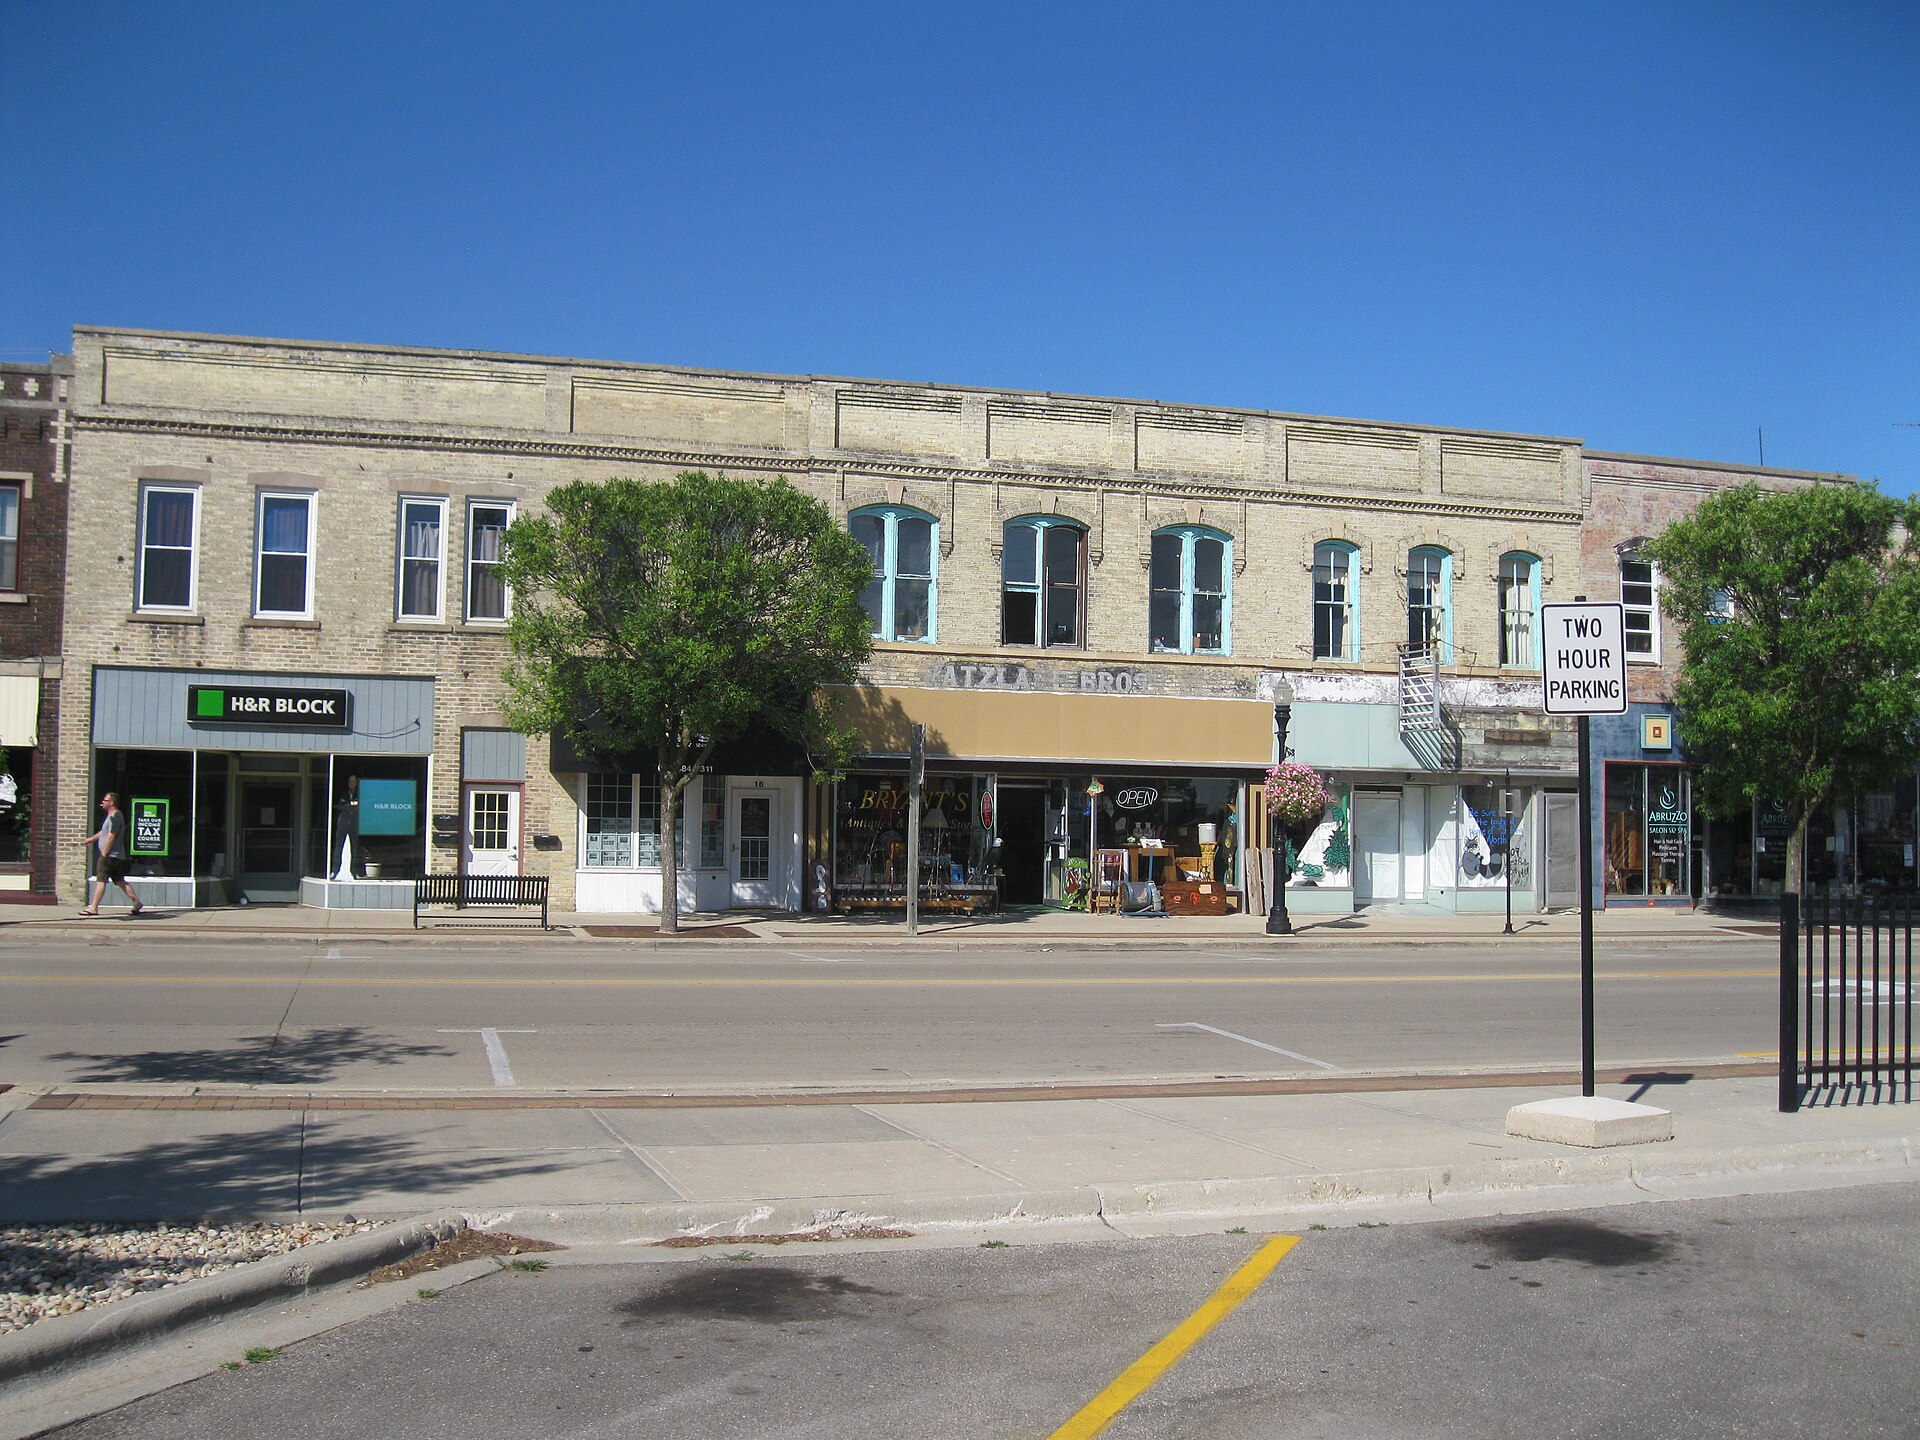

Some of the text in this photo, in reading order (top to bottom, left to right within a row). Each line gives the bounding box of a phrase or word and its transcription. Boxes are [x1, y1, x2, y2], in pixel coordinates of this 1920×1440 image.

[1562, 617, 1602, 638] TWO
[1557, 648, 1611, 669] HOUR
[1549, 679, 1620, 699] PARKING
[231, 696, 336, 715] H&R BLOCK
[754, 780, 764, 788] 16
[1117, 789, 1155, 806] OPEN
[1648, 810, 1688, 823] ABRUZZO
[1761, 814, 1788, 825] ABRUZ
[137, 827, 161, 837] TAX
